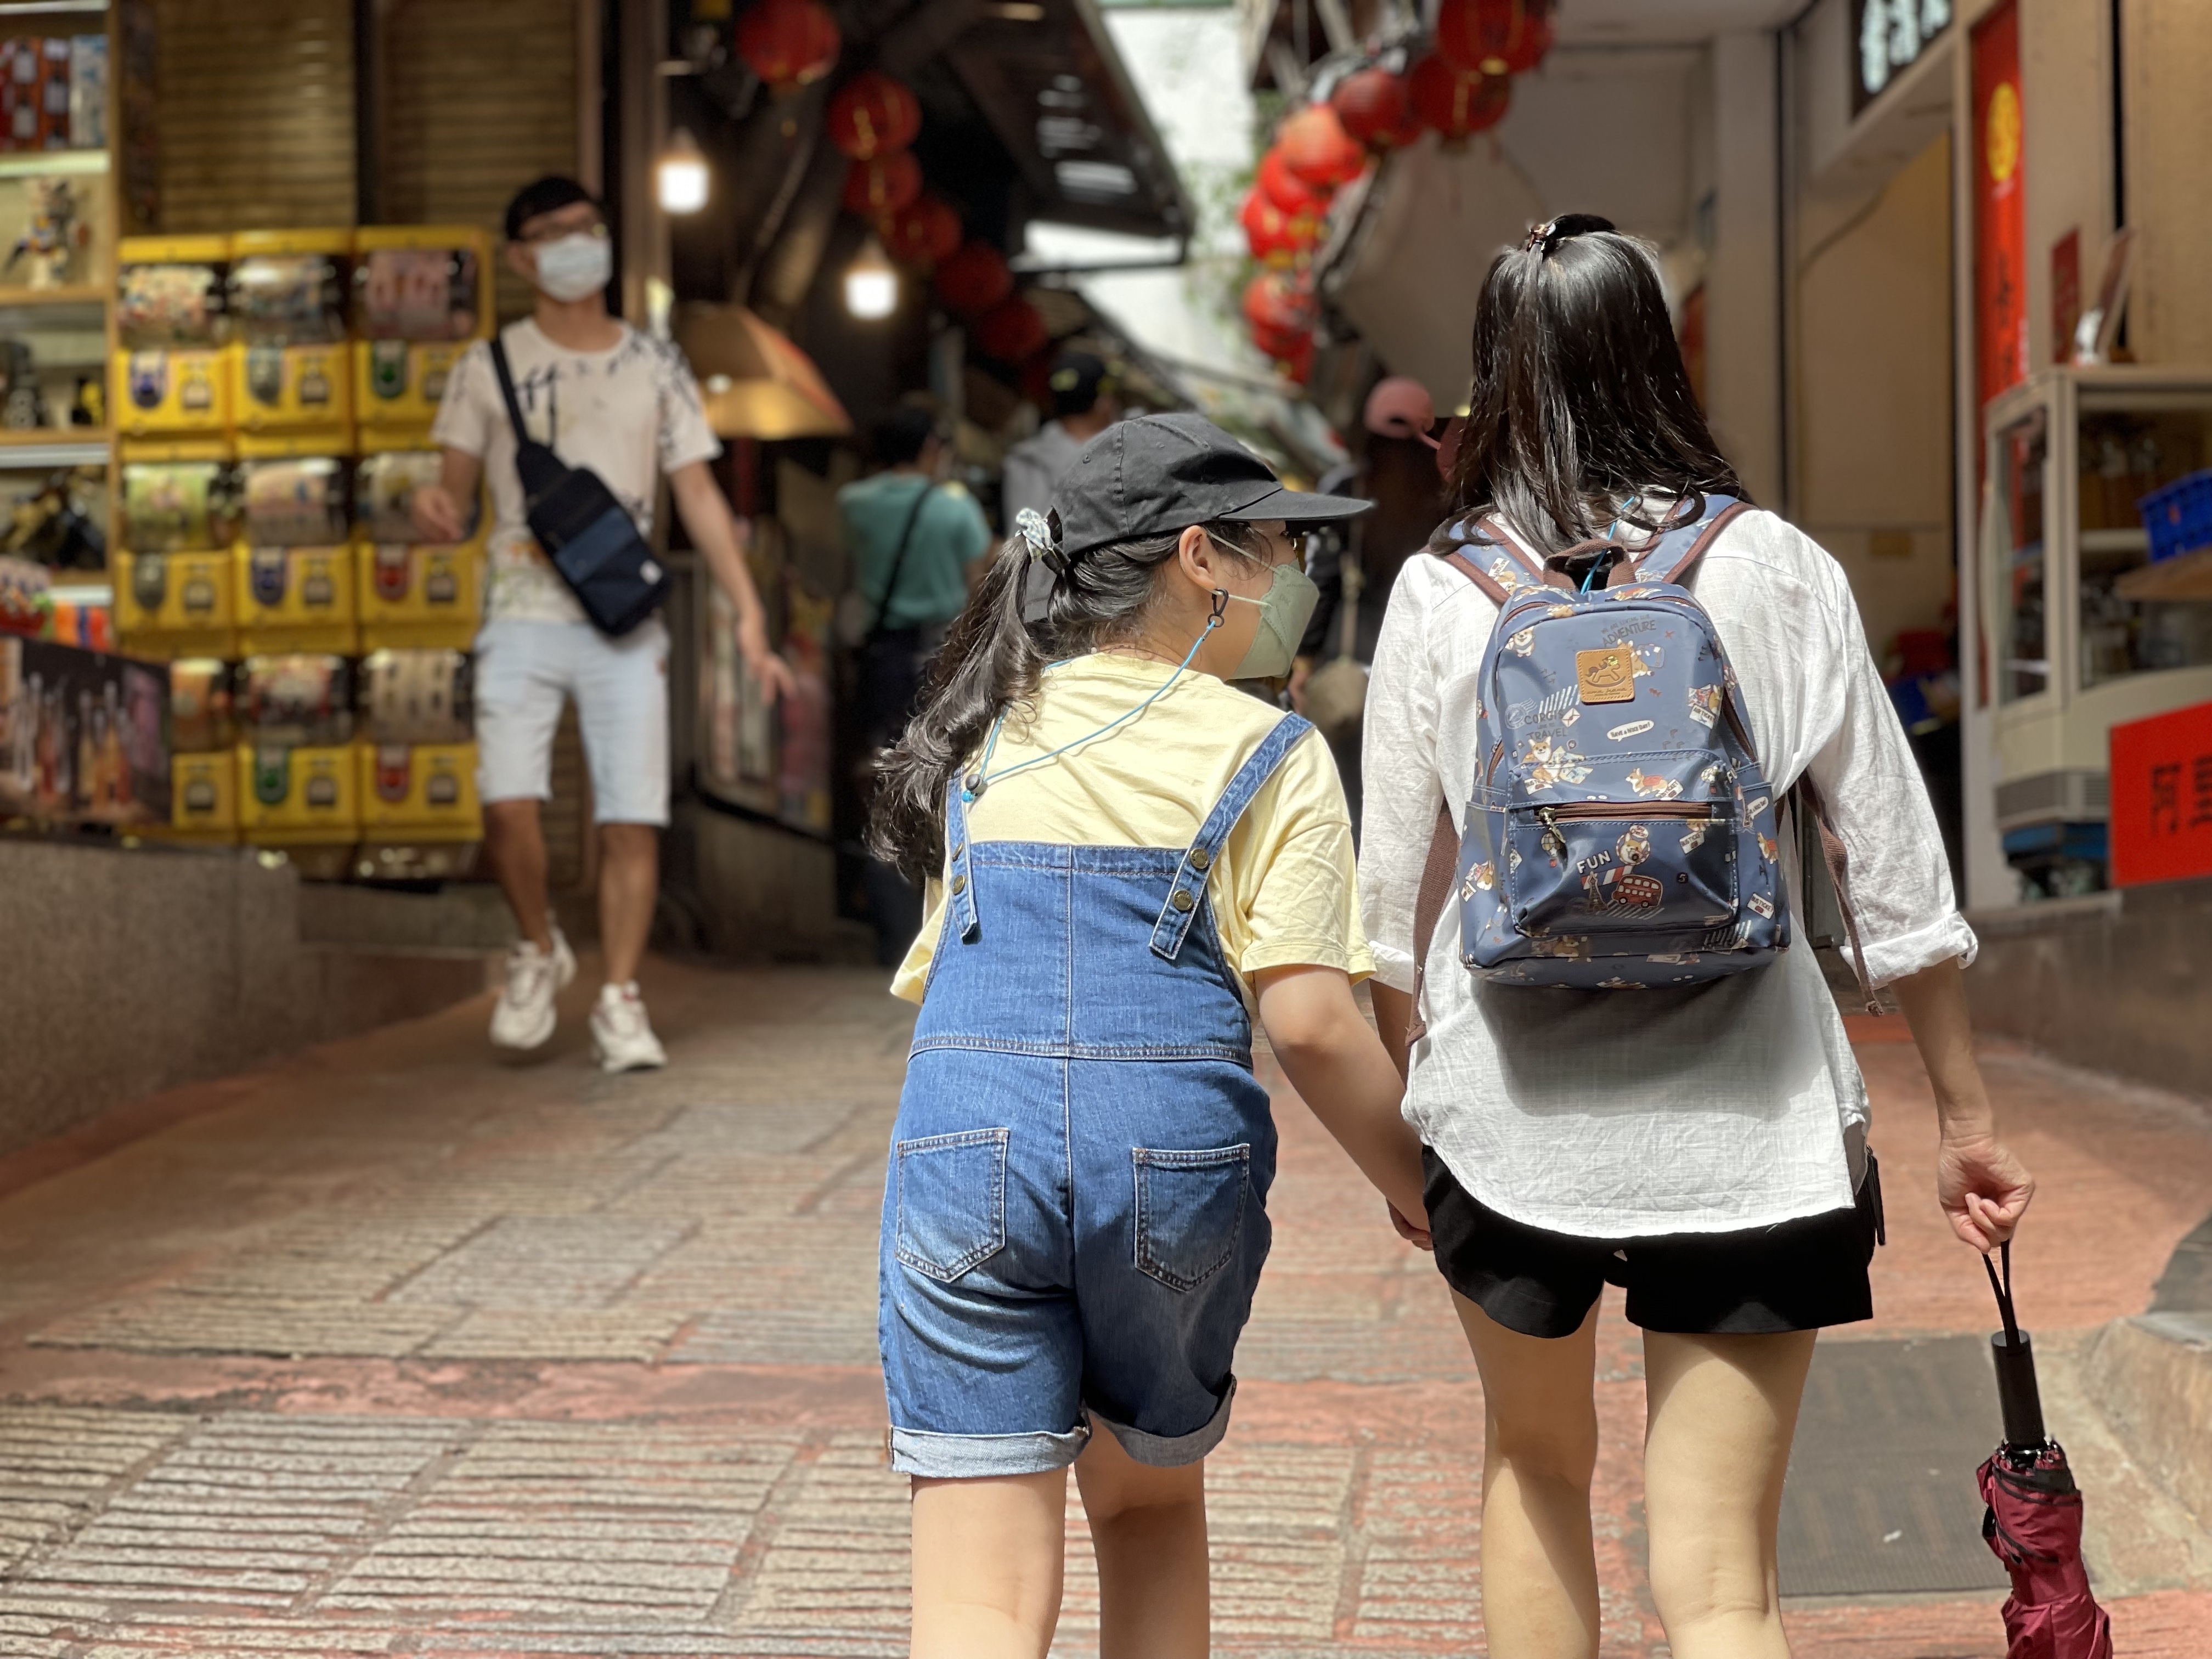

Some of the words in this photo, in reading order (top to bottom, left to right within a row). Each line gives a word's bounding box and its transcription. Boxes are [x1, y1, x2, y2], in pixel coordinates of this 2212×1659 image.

[1602, 619, 1657, 647] ADVENTURE
[1524, 709, 1564, 725] CORGIS
[1526, 727, 1567, 740] TRAVEL
[1576, 850, 1612, 874] FUN
